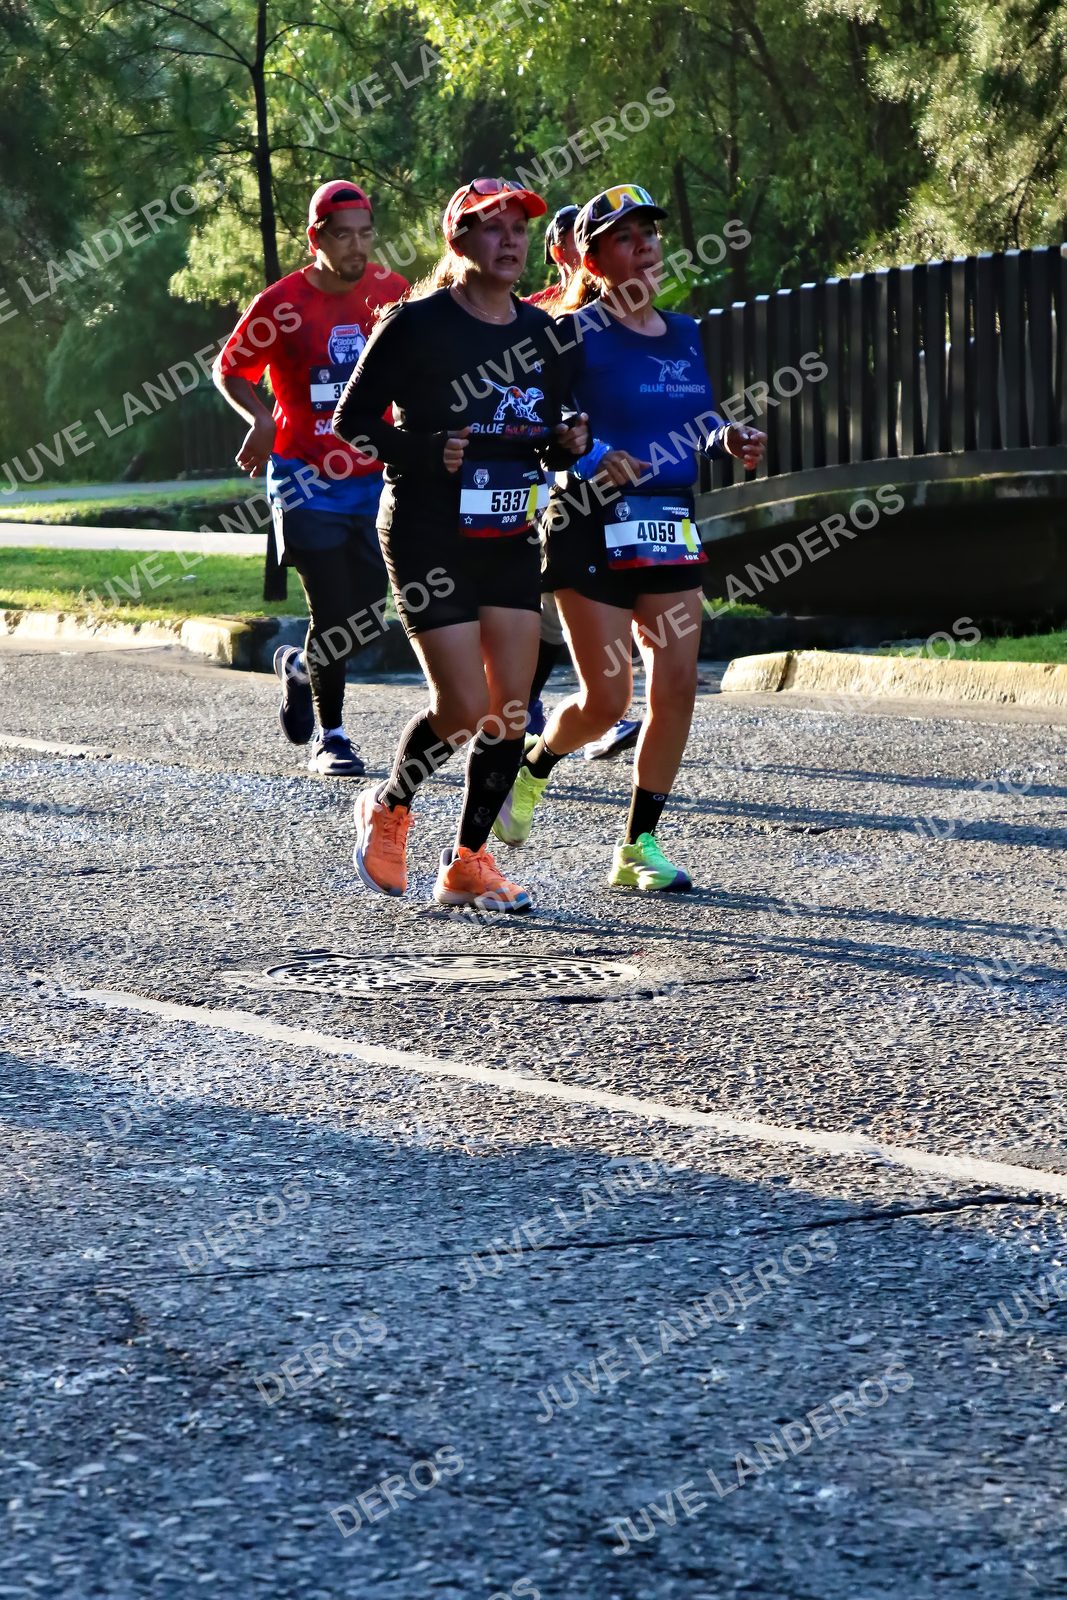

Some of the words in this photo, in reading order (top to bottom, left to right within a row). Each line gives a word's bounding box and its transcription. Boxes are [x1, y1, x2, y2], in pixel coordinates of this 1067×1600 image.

[337, 336, 357, 346] Global
[334, 345, 350, 353] Race
[639, 383, 665, 393] BLUE
[665, 383, 706, 394] RUNNERS
[470, 422, 504, 434] BLUE
[491, 489, 530, 513] 5337
[637, 521, 676, 543] 4059
